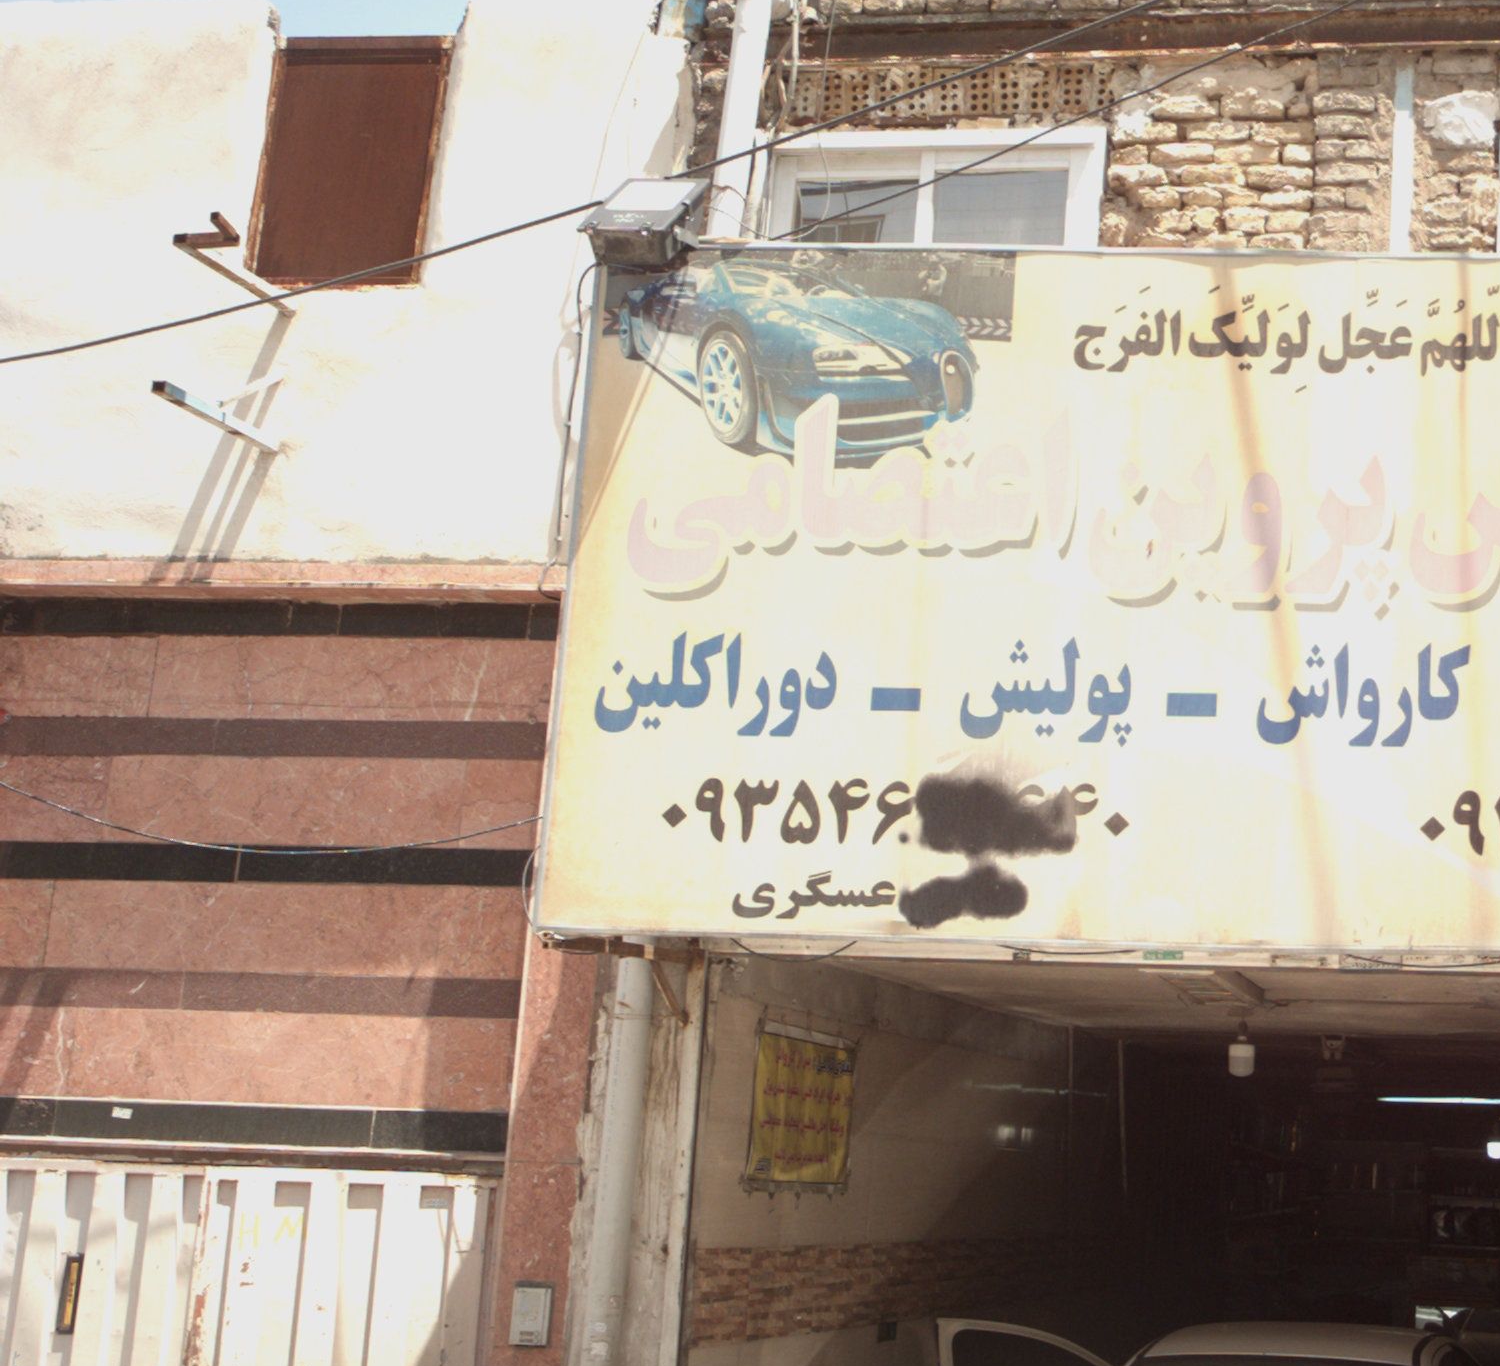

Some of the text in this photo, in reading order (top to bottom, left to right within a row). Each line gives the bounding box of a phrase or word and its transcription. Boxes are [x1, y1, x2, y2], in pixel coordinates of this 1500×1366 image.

[625, 397, 1078, 597] اعتصامی
[1088, 451, 1394, 615] پروین
[959, 637, 1133, 747] پولیش
[1256, 643, 1471, 748] کارواش
[662, 776, 1130, 846] ۰۹۳۵۴۶۴۰
[732, 869, 897, 920] عسگری
